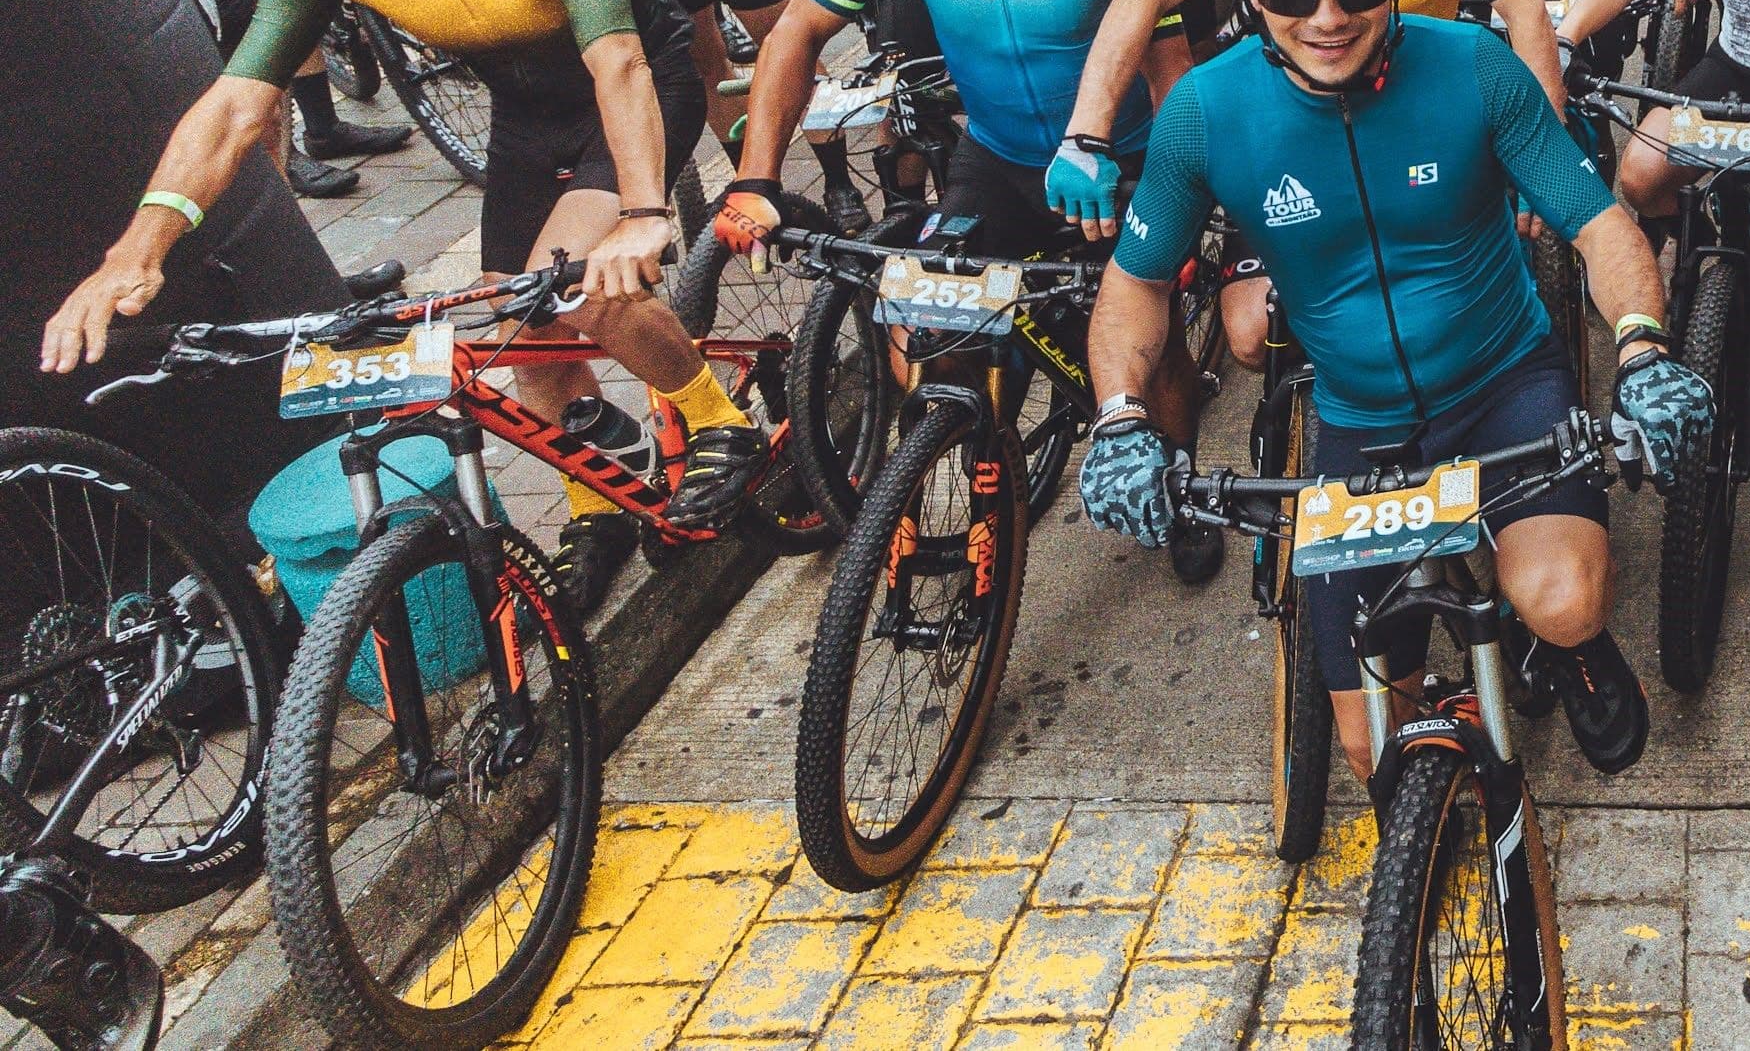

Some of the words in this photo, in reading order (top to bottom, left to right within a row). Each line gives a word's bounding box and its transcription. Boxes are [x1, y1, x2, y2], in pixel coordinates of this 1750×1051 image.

[1263, 198, 1316, 217] TOUR
[910, 278, 983, 311] 252
[325, 352, 411, 390] 353
[1341, 495, 1434, 541] 289
[502, 539, 558, 597] MAXXIS
[115, 620, 157, 643] EPIC
[116, 664, 184, 754] SPECIALIZED
[185, 841, 247, 873] RENEGADE
